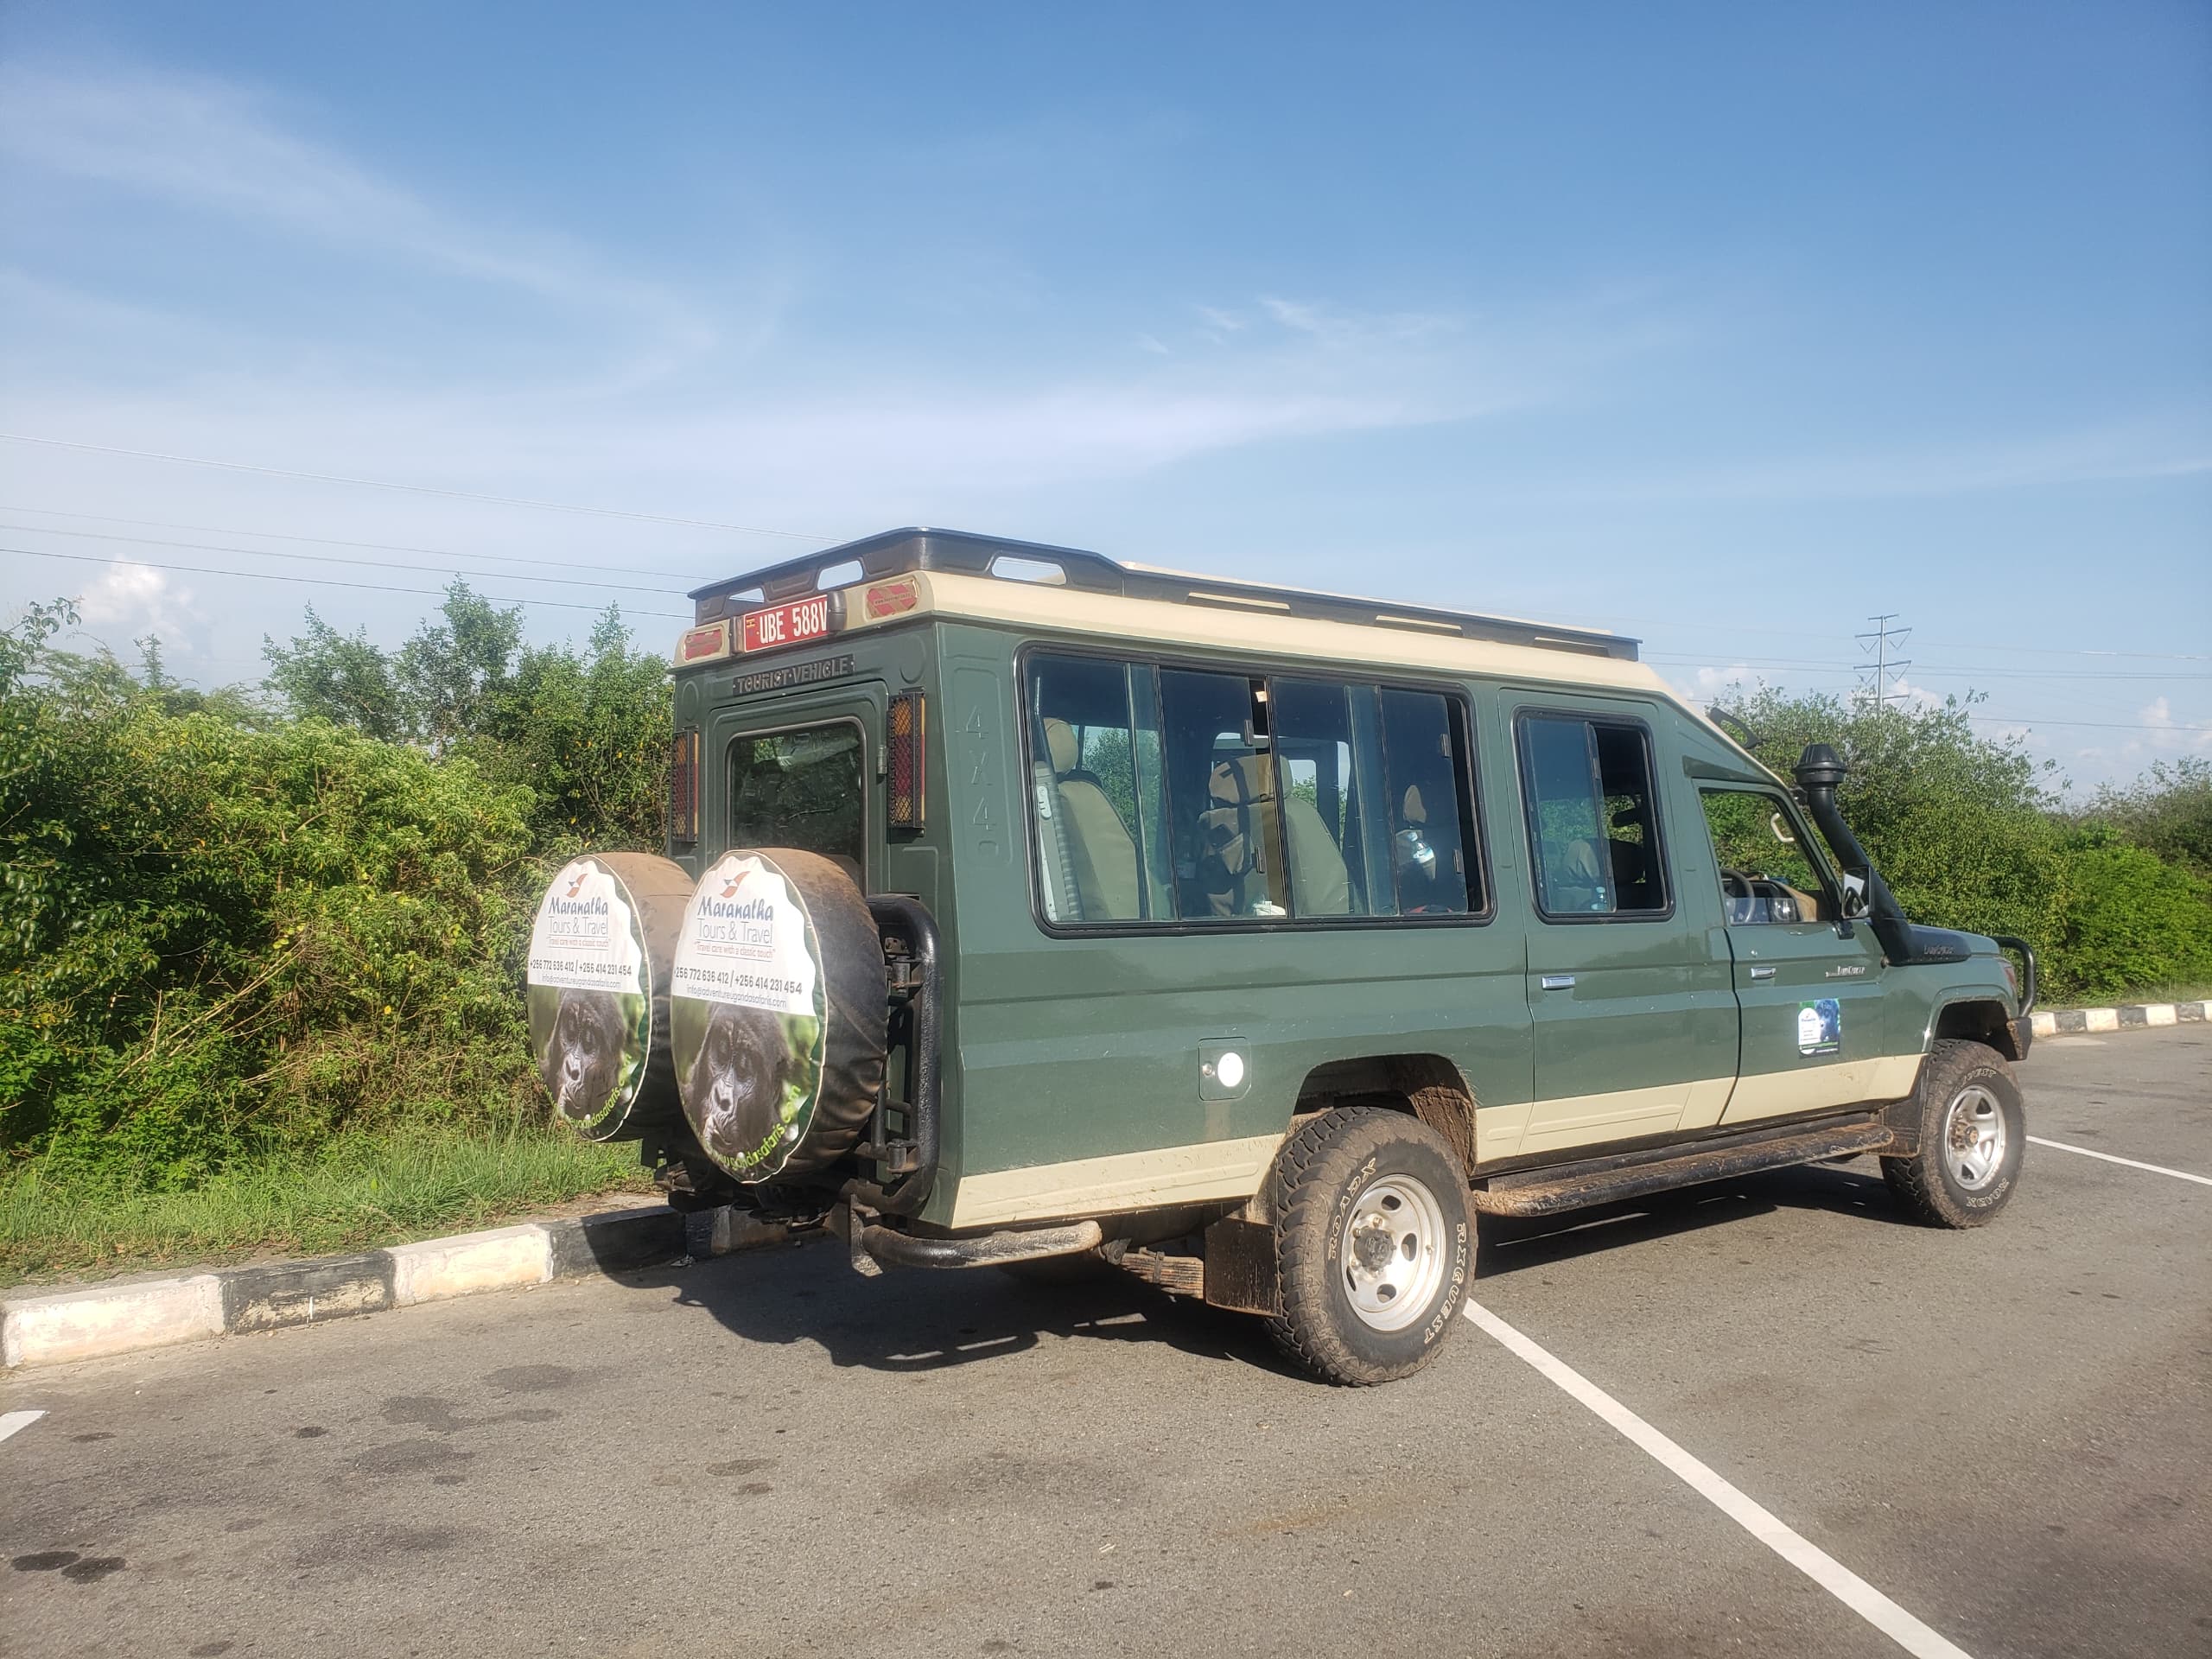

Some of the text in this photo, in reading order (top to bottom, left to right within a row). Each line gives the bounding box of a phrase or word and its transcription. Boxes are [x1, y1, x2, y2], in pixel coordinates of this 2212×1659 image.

[760, 601, 828, 644] UBE 588V
[737, 658, 848, 693] TOURIST VEHICLE
[548, 897, 608, 916] Maranatha
[697, 896, 774, 922] Maranatha
[548, 916, 608, 935] Tours & Travel
[697, 918, 773, 944] Tours & Travel
[543, 959, 552, 969] 772
[564, 962, 575, 972] 412
[579, 962, 594, 973] +256
[596, 963, 607, 975] 414
[607, 964, 617, 975] 231
[618, 964, 632, 976] 454
[690, 968, 701, 980] 772
[702, 969, 715, 982] 636
[716, 972, 729, 984] 412
[734, 975, 753, 988] +256
[755, 976, 768, 989] 414
[770, 978, 783, 992] 231
[784, 981, 802, 995] 454
